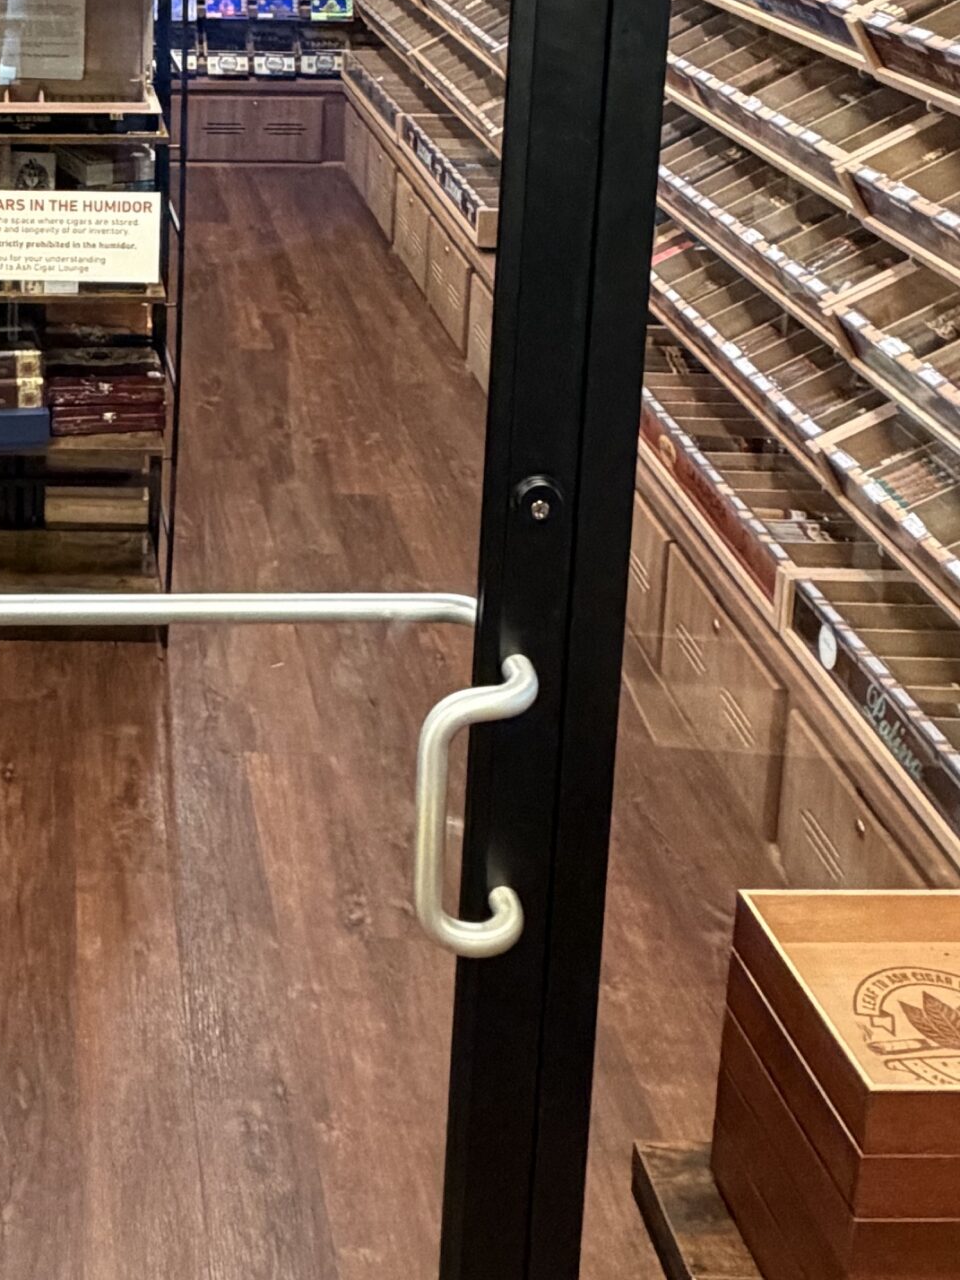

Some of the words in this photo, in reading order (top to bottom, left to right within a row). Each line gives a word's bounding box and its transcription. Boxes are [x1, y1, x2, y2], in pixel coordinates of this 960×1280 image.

[30, 199, 45, 211] IN
[48, 199, 78, 212] THE
[82, 200, 153, 213] HUMIDOR
[11, 217, 35, 225] space
[66, 218, 92, 226] cigars
[21, 227, 59, 235] longevity
[25, 241, 71, 249] prohibited
[45, 256, 107, 265] understanding
[33, 264, 56, 272] Cigar
[58, 265, 89, 273] Lounge
[862, 987, 878, 1012] LEAF
[871, 979, 890, 991] TO
[885, 972, 911, 985] ASH
[911, 971, 953, 986] CIGAR
